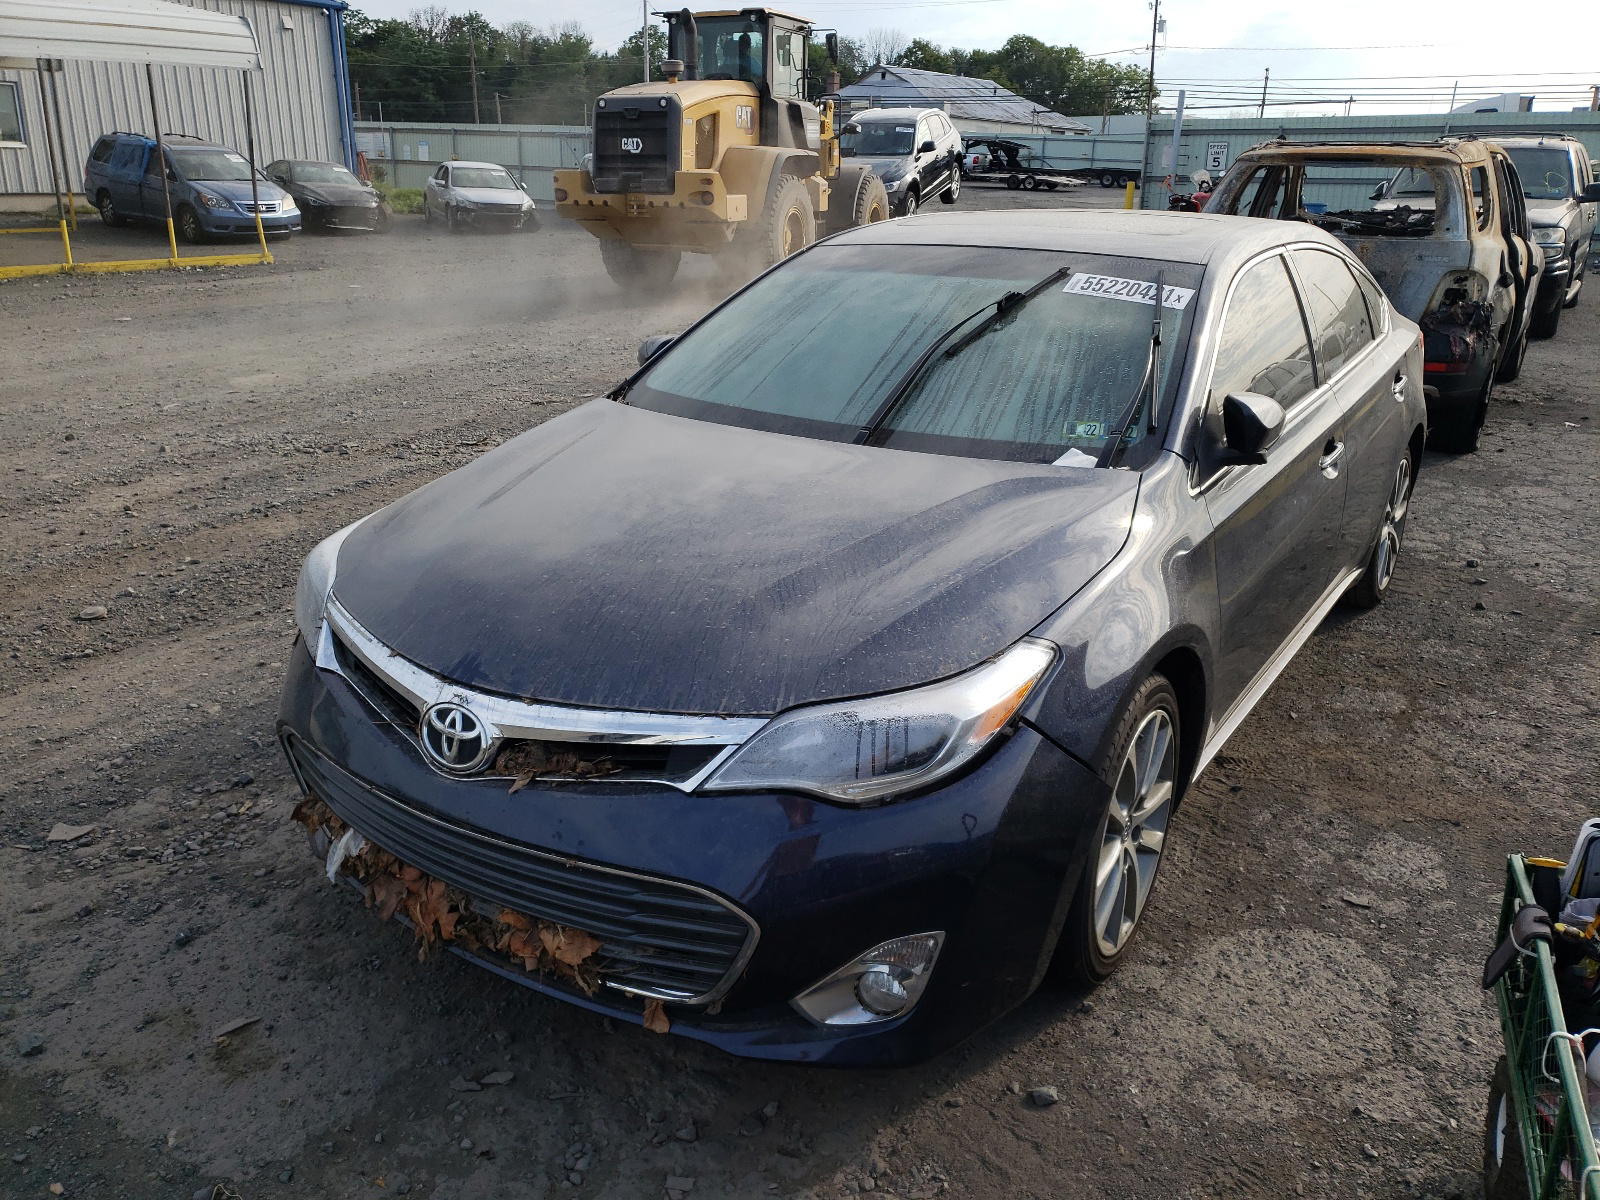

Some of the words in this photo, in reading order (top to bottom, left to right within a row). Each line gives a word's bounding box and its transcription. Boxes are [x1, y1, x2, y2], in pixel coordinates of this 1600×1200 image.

[736, 105, 752, 128] CAT
[621, 138, 639, 151] CAT
[1212, 156, 1221, 168] 5
[1086, 424, 1097, 436] 22
